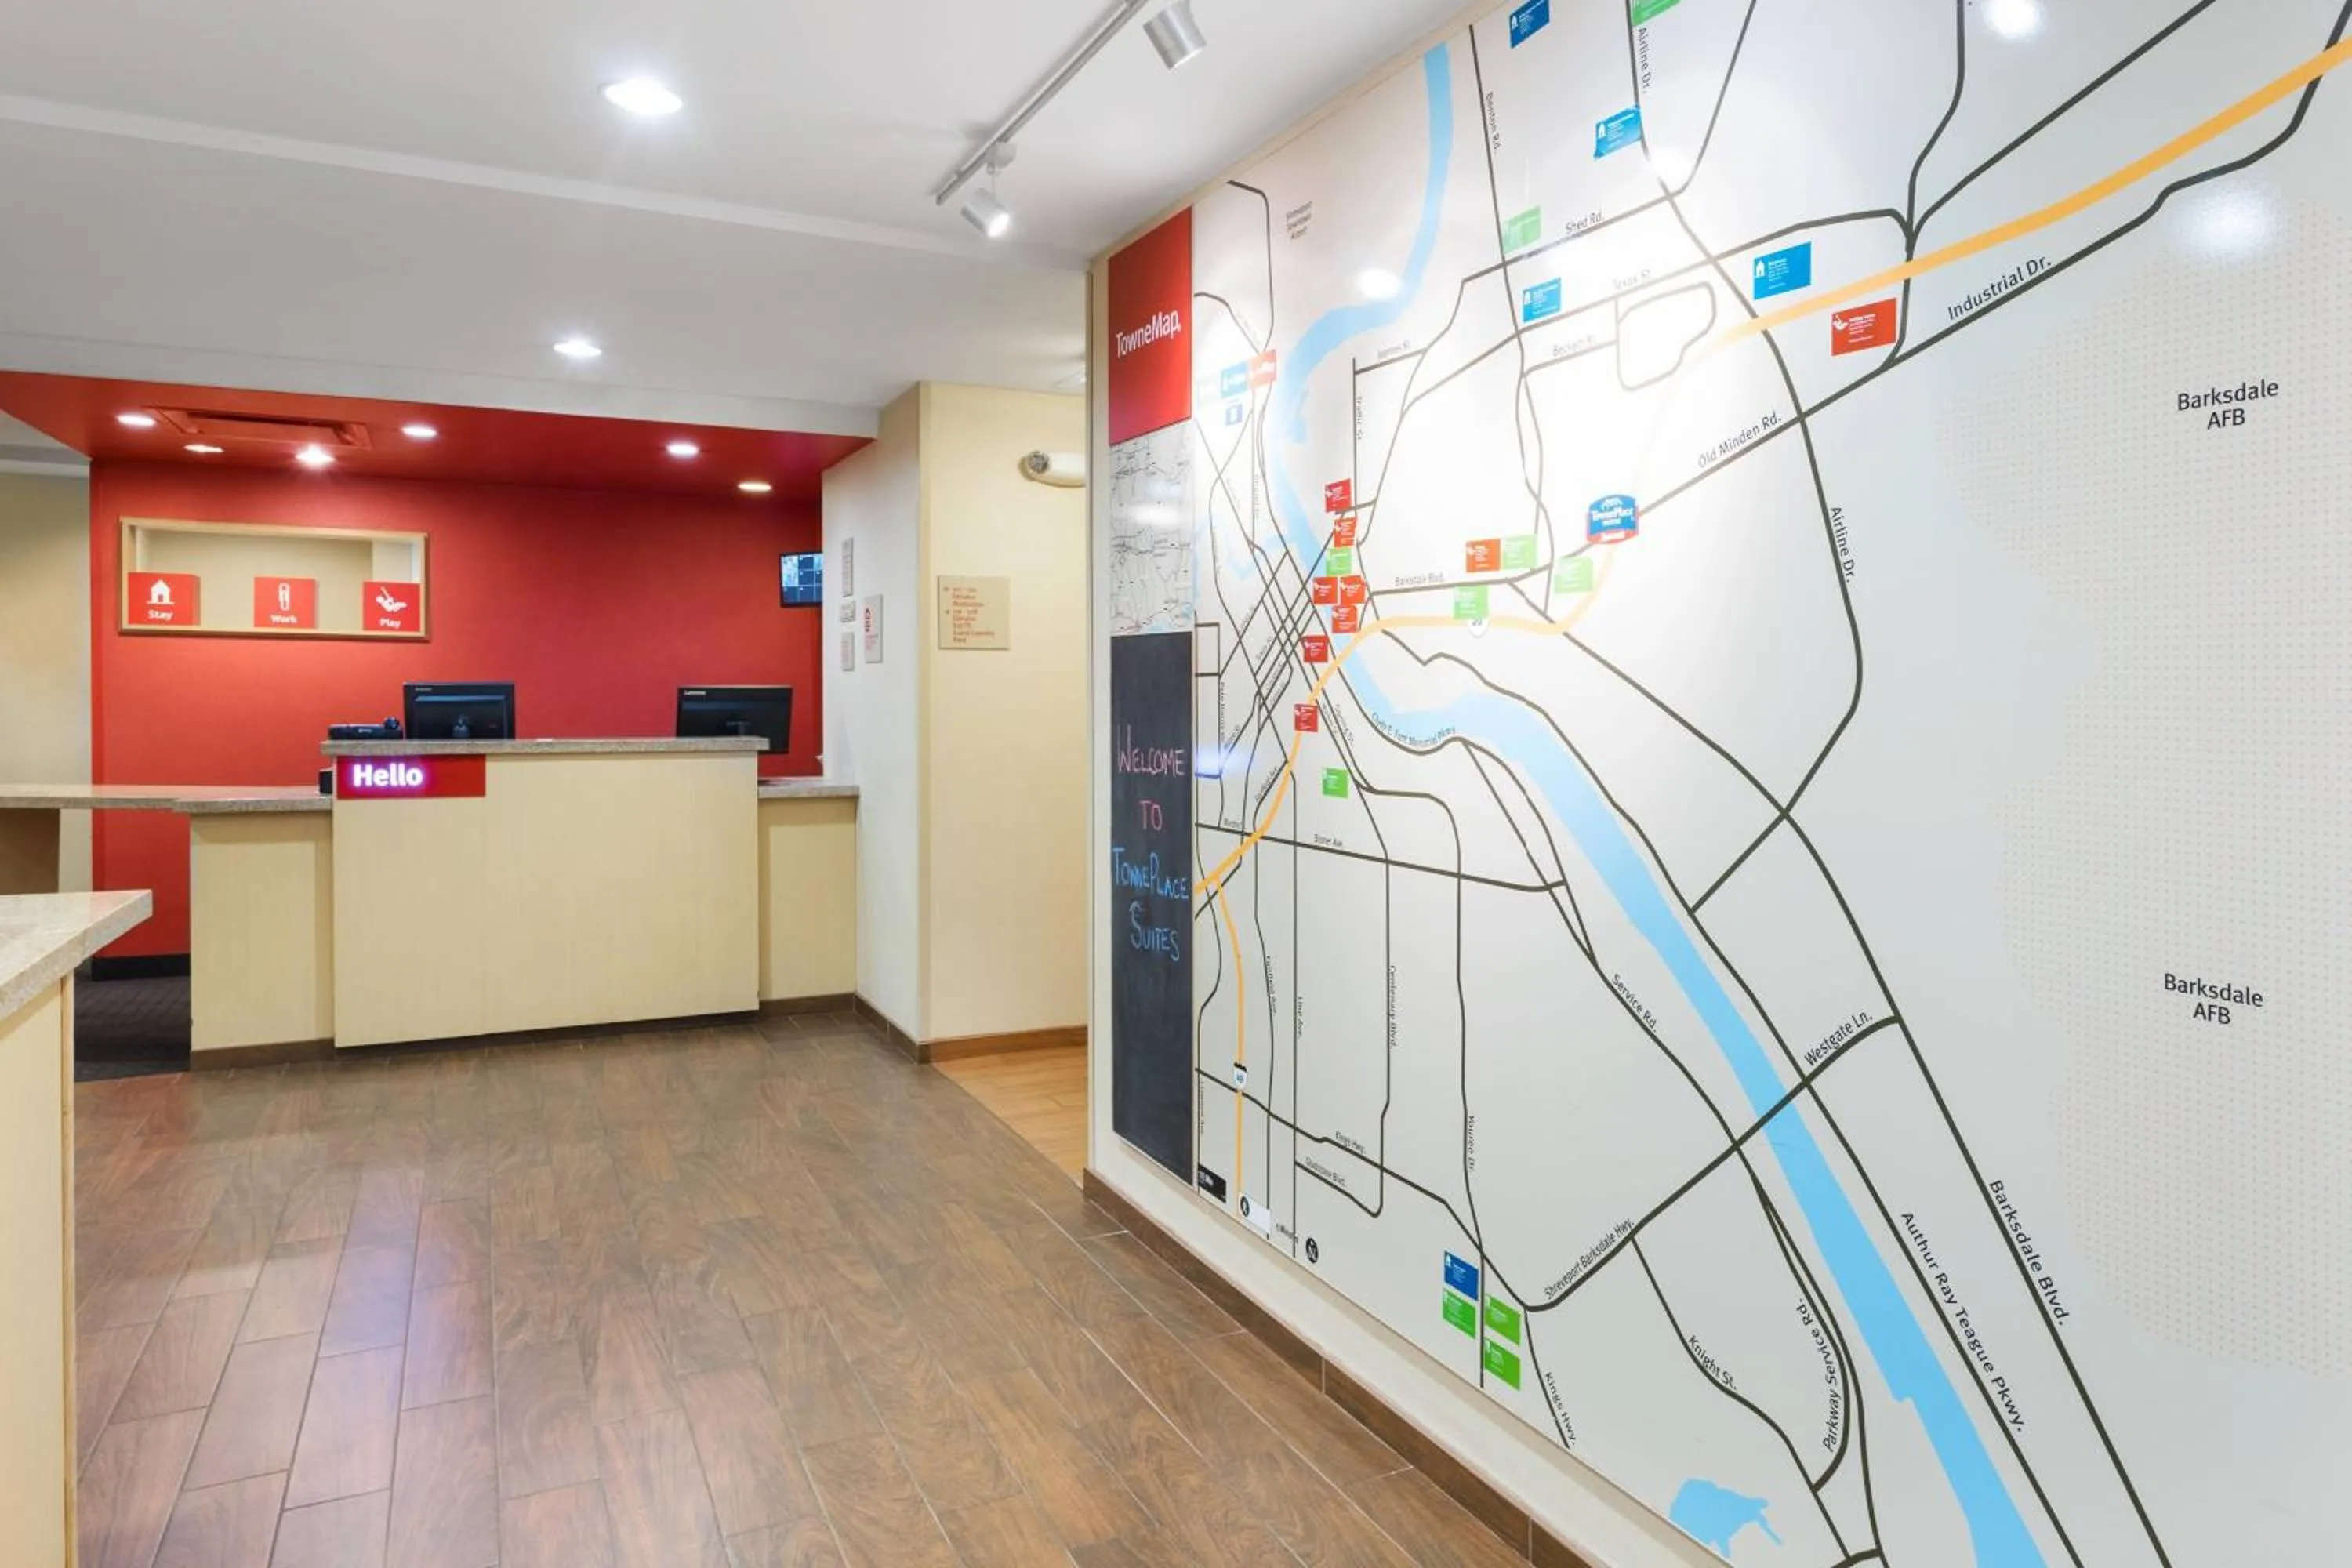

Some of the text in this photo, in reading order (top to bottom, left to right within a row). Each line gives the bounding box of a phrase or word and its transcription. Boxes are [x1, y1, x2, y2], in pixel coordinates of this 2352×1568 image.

[1638, 27, 1649, 71] Airline
[1566, 217, 1588, 233] Shed
[1947, 256, 2052, 320] Industrial Dr.
[2178, 379, 2279, 411] Barksdale
[2207, 407, 2246, 430] AFB
[1697, 409, 1782, 468] Old Minden Rd.
[1831, 507, 1854, 584] Airline Dr.
[147, 608, 173, 622] Stay
[270, 614, 297, 625] Work
[379, 617, 401, 629] Play
[1117, 724, 1186, 777] WELCOME
[353, 762, 423, 788] Hello
[1139, 800, 1163, 831] TO
[1129, 900, 1180, 962] SUITES
[1611, 973, 1657, 1033] Service Rd.
[2164, 973, 2263, 1007] Barksdale
[2193, 1001, 2231, 1025] AFB
[1804, 1011, 1873, 1066] Westgate Ln.
[1544, 1218, 1635, 1301] Shreveport Barksdale Hwy.
[1989, 1179, 2070, 1327] Barksdale Blvd.
[1901, 1212, 2025, 1432] Authur Ray Teague Pkwy.
[1688, 1334, 1737, 1391] Knight St.
[1796, 1298, 1842, 1453] Parkway Service Rd.
[1544, 1372, 1563, 1410] Kings
